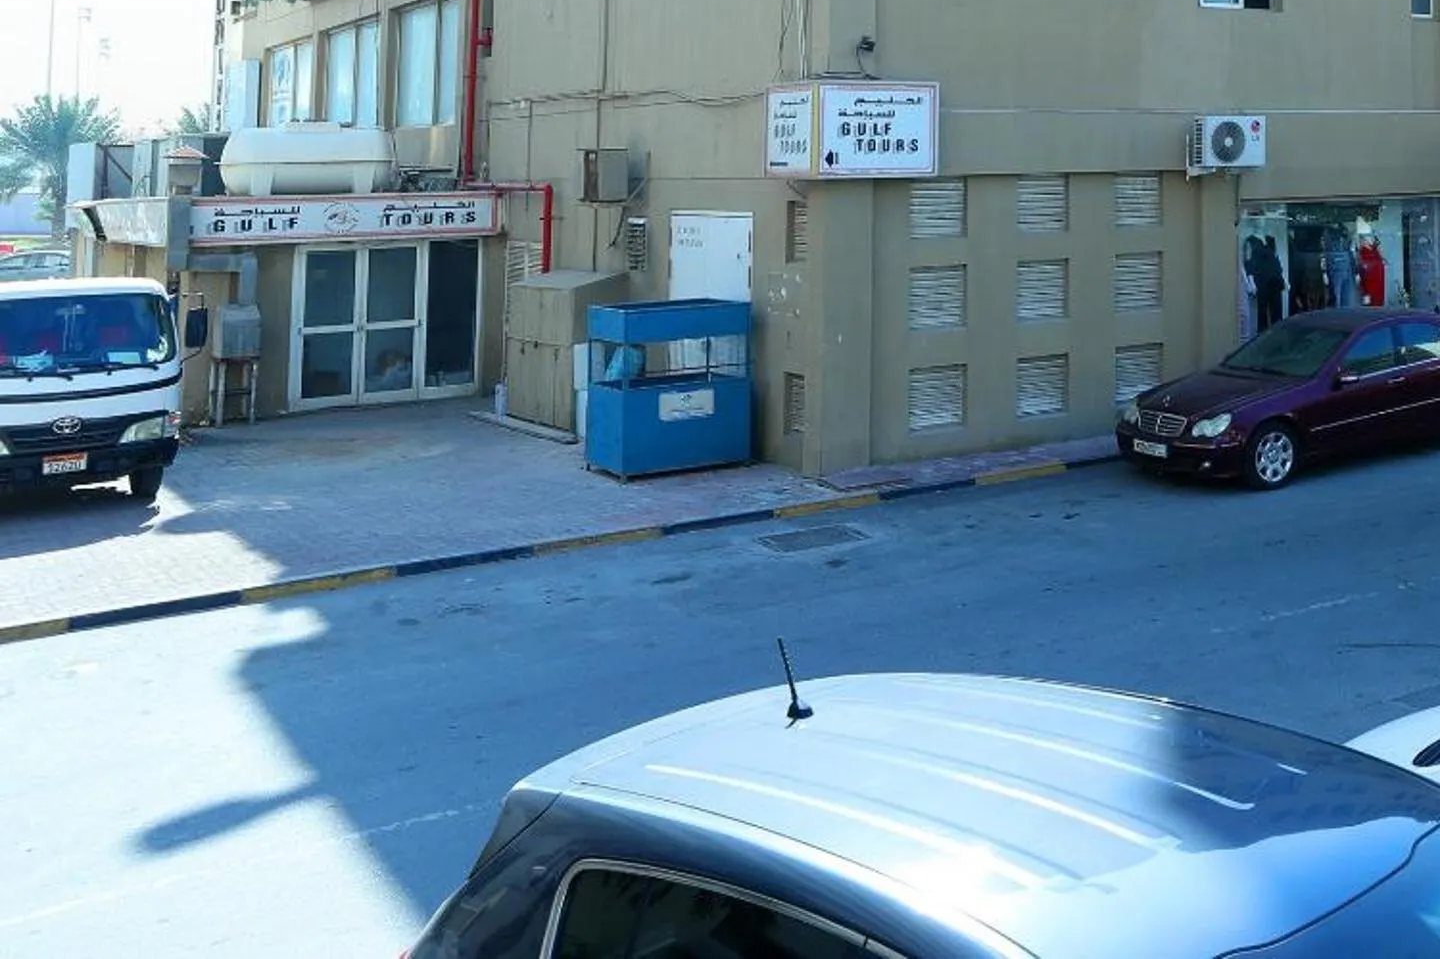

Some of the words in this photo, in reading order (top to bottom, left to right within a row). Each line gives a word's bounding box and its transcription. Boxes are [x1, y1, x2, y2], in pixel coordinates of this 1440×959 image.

[839, 122, 892, 138] GULF
[855, 138, 919, 154] TOURS
[208, 217, 299, 234] GULF
[380, 210, 476, 228] TOURS
